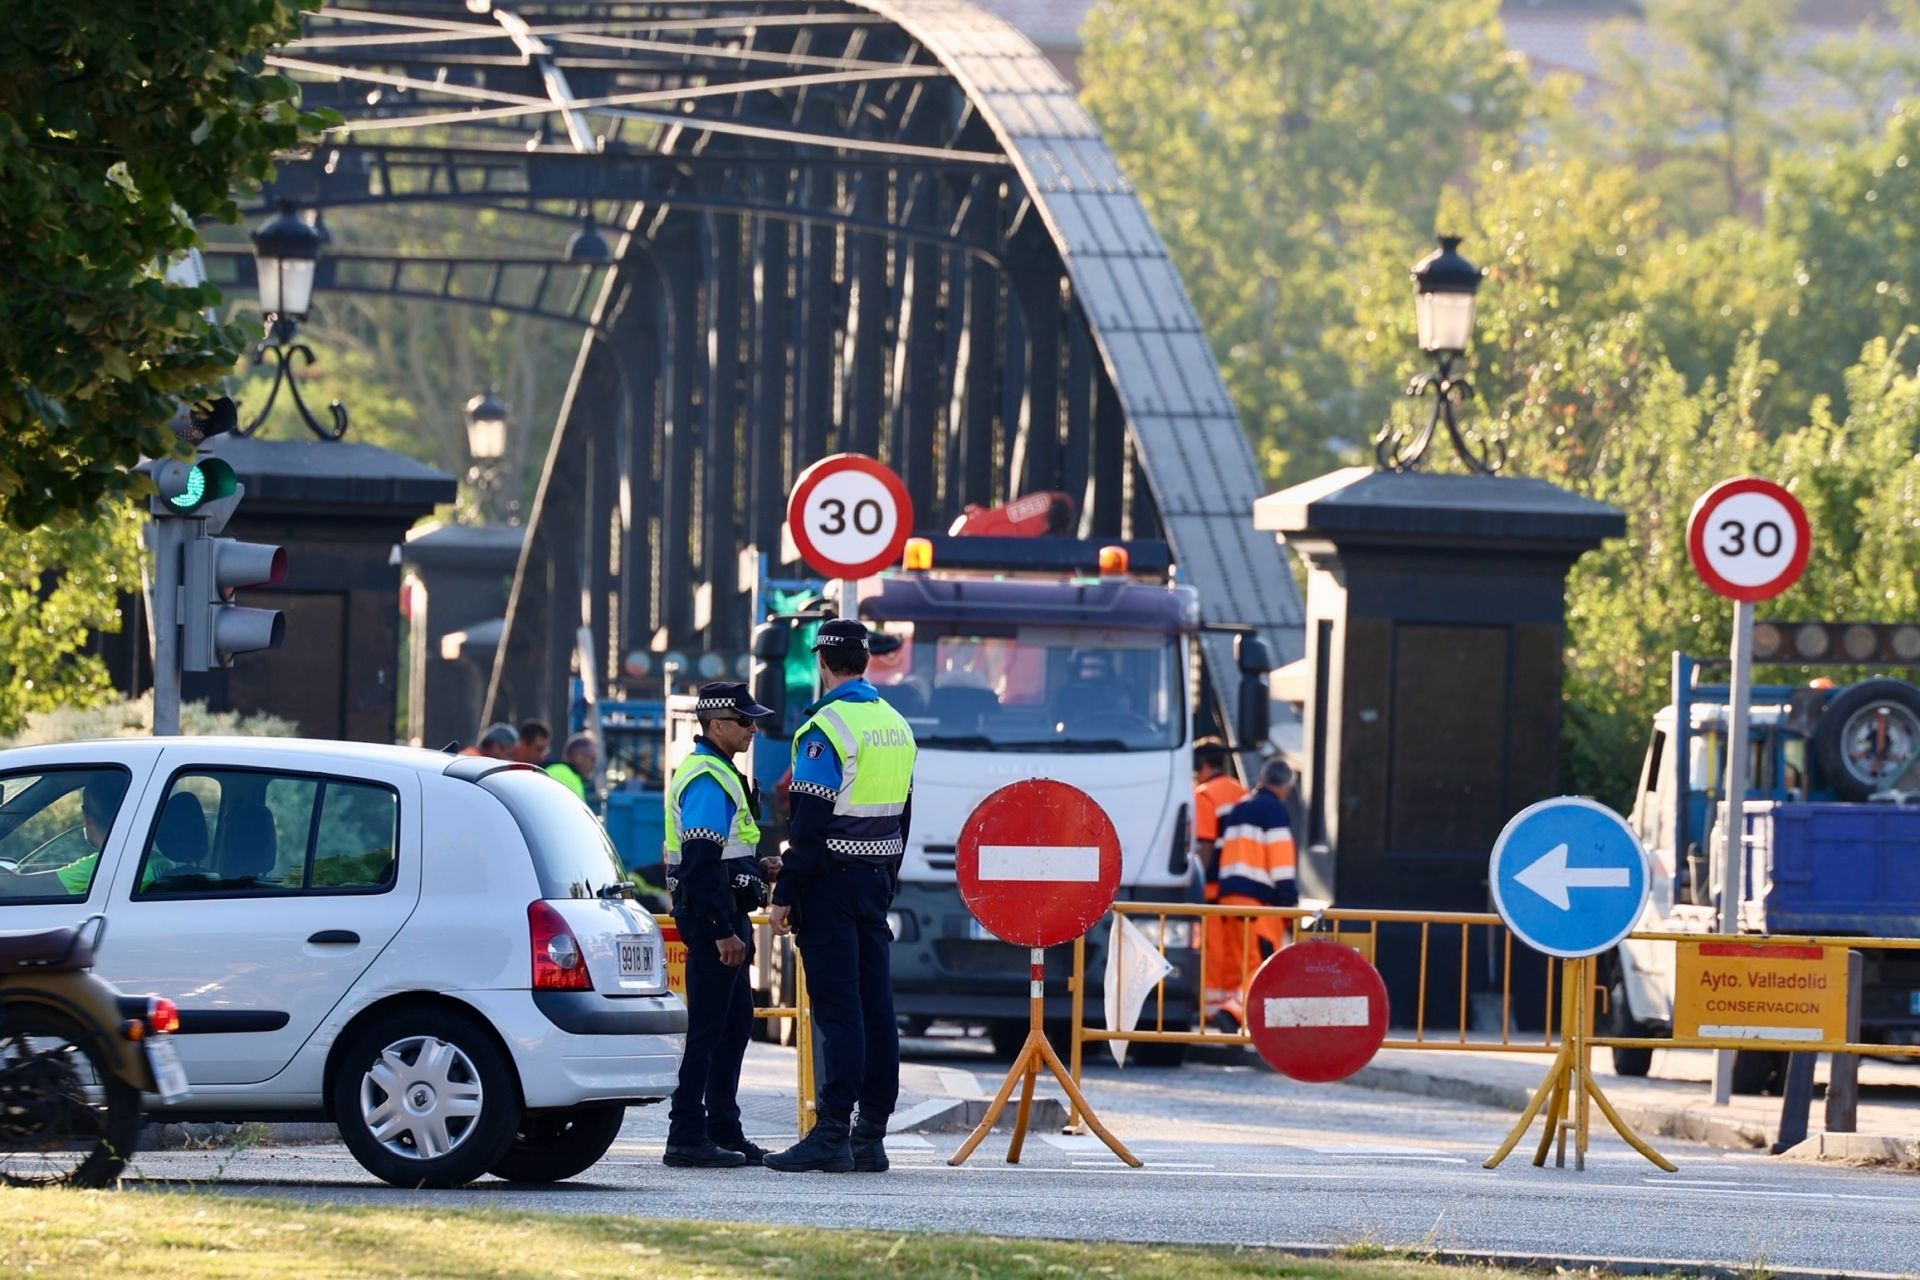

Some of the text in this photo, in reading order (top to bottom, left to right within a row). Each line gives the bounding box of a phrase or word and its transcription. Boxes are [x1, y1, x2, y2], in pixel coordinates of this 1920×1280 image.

[819, 498, 883, 535] 30
[1719, 520, 1783, 558] 30
[622, 945, 641, 971] 9918
[1700, 970, 1827, 991] Ayto. Valladolid
[1706, 1000, 1820, 1014] CONSERVACION
